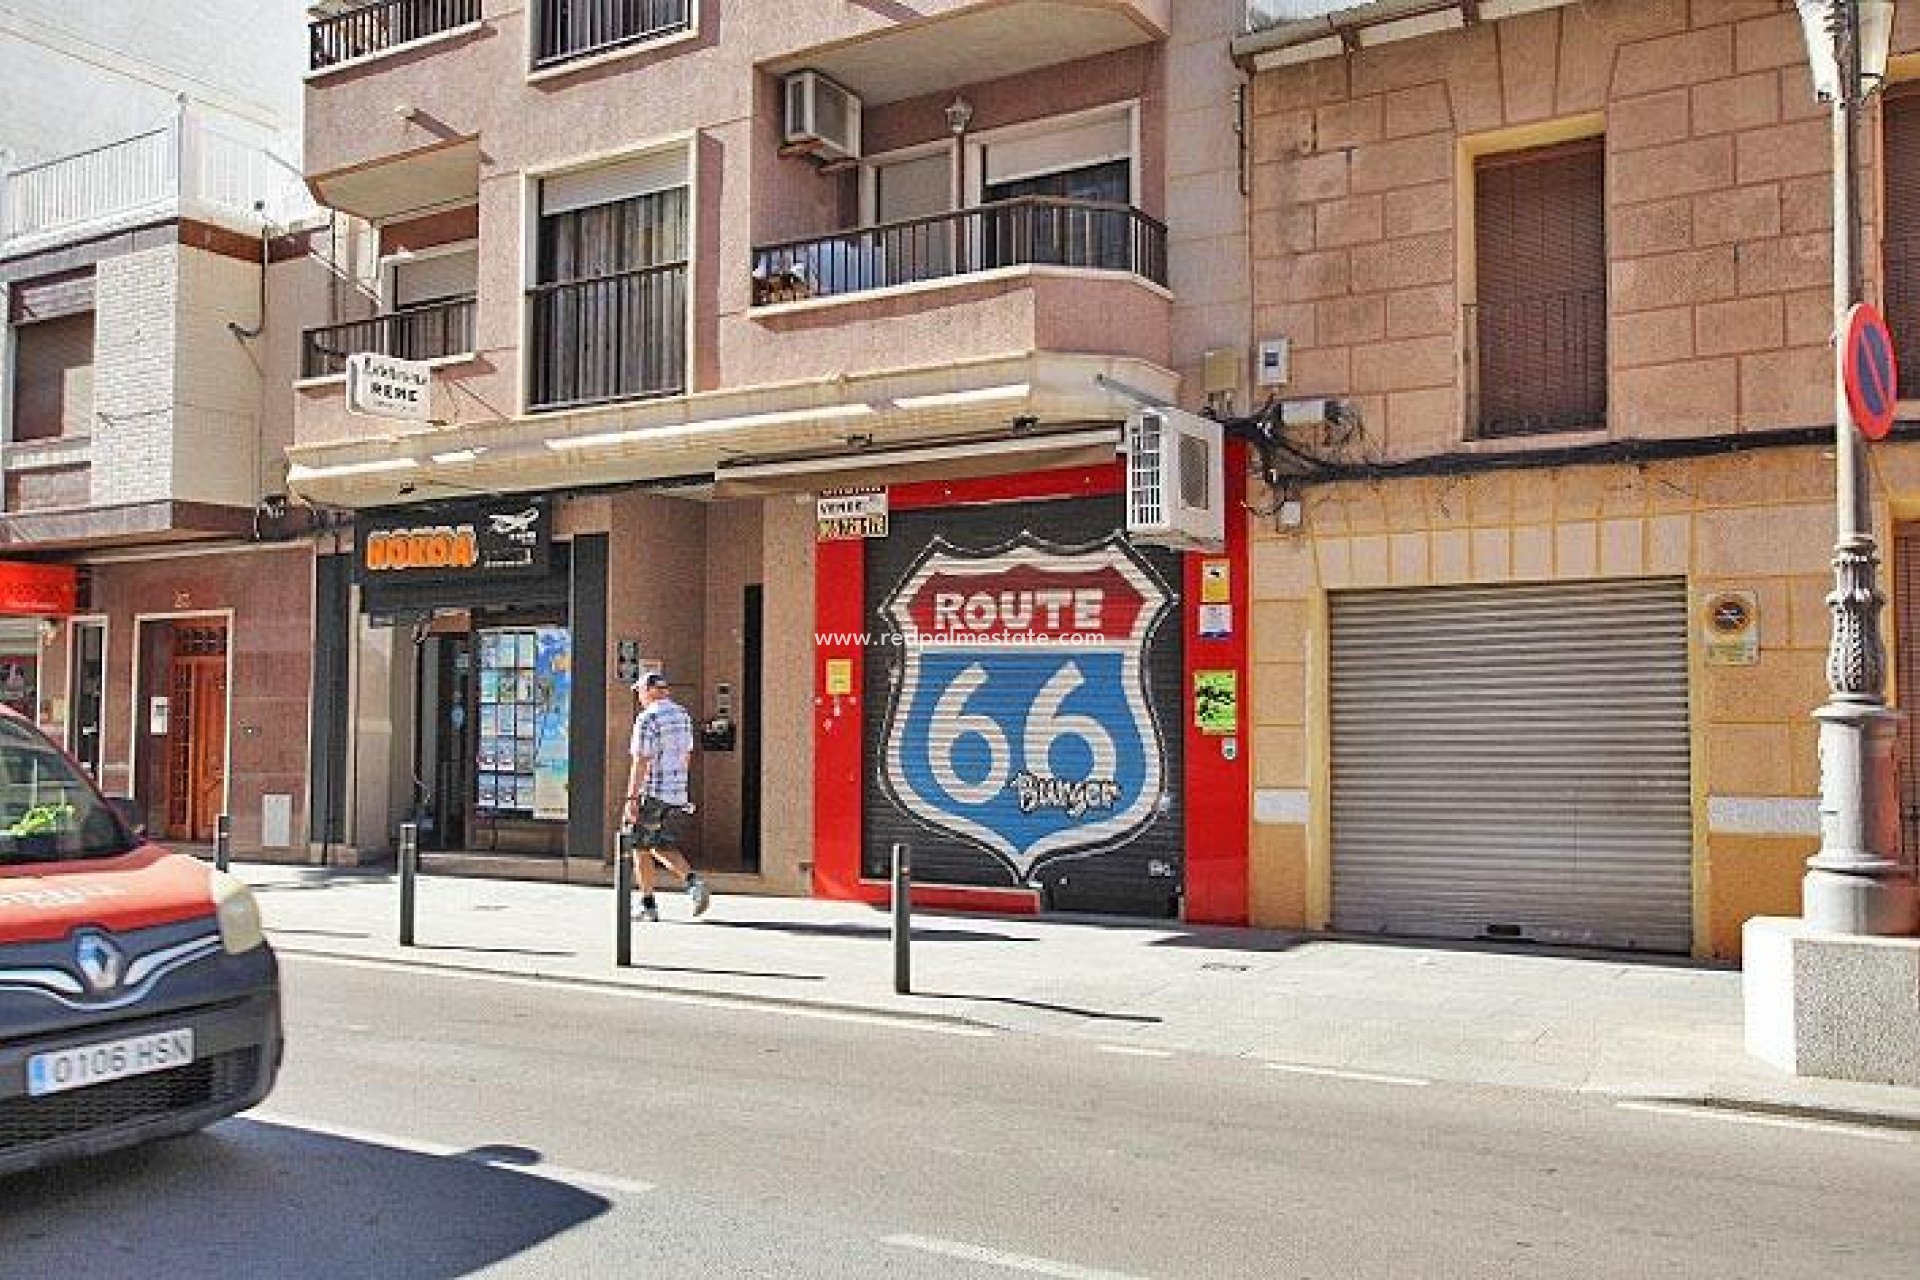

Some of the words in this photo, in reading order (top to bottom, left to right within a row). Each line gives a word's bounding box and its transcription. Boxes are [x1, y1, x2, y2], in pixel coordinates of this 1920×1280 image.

[933, 588, 1105, 631] ROUTE
[928, 661, 1117, 804] 66
[1010, 771, 1122, 818] Burger
[56, 1046, 127, 1083] 0106
[136, 1035, 190, 1069] HSN
